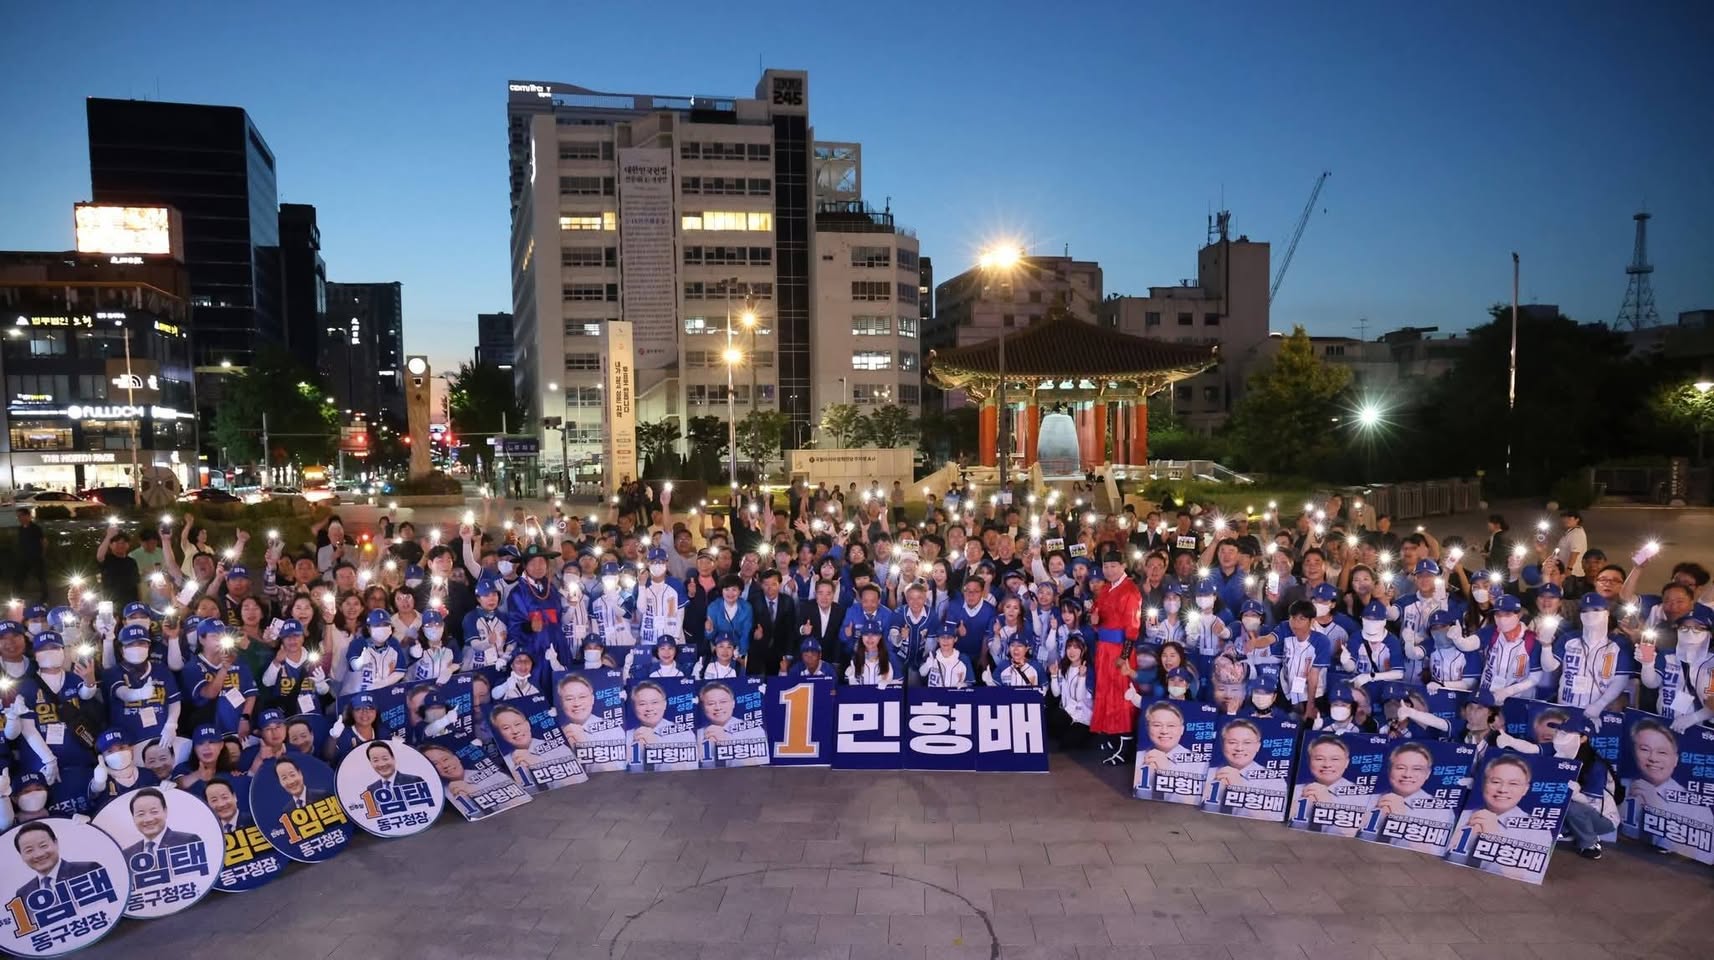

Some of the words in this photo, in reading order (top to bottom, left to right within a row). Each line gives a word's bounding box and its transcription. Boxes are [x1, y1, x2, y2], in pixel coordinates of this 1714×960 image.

[773, 90, 803, 106] 245
[624, 165, 668, 176] 대한민국헌법
[31, 316, 69, 326] 법무법인
[39, 633, 55, 641] 임택
[130, 627, 144, 636] 임택
[1513, 654, 1527, 679] 1
[1600, 652, 1616, 679] 1
[457, 676, 472, 684] 민주당
[607, 670, 621, 678] 민주당
[1561, 655, 1580, 704] 민형배
[391, 687, 405, 695] 민주당
[596, 687, 621, 700] 압도적
[1661, 671, 1680, 719] 민형배
[604, 697, 622, 707] 성장
[668, 693, 694, 706] 압도적
[736, 692, 761, 705] 압도적
[677, 702, 694, 712] 성장
[745, 701, 762, 710] 성장
[1201, 704, 1217, 713] 민주당
[264, 711, 279, 720] 임택
[381, 704, 405, 723] 압도적
[603, 709, 610, 719] 더
[614, 707, 623, 718] 큰
[675, 714, 684, 724] 더
[686, 712, 694, 722] 큰
[743, 712, 753, 721] 더
[754, 709, 763, 719] 큰
[389, 714, 406, 729] 성장
[540, 717, 556, 730] 성장
[589, 717, 624, 733] 전남광주
[729, 718, 764, 733] 전남광주
[773, 682, 820, 758] 1
[837, 701, 1044, 755] 민형배
[1281, 721, 1297, 729] 민주당
[1603, 715, 1623, 725] 민주당
[200, 727, 215, 735] 임택
[661, 722, 694, 736] 전남광주
[1186, 722, 1215, 732] 압도적
[105, 730, 122, 741] 임택
[542, 730, 553, 741] 더
[553, 727, 562, 737] 큰
[1194, 731, 1214, 740] 성장
[1370, 736, 1387, 745] 민주당
[534, 735, 566, 755] 전남광주
[1192, 743, 1202, 753] 더
[1203, 743, 1213, 752] 큰
[1263, 738, 1293, 749] 압도적
[576, 744, 627, 765] 민형배
[630, 742, 642, 764] 1
[645, 747, 697, 765] 민형배
[701, 739, 713, 762] 1
[717, 742, 767, 761] 민형배
[1271, 748, 1292, 757] 성장
[1456, 746, 1474, 755] 민주당
[474, 760, 484, 770] 더
[483, 757, 493, 767] 큰
[1174, 752, 1212, 763] 전남광주
[1267, 760, 1277, 769] 더
[1279, 759, 1290, 769] 큰
[1351, 753, 1383, 765] 압도적
[1360, 763, 1382, 773] 성장
[1433, 764, 1467, 776] 압도적
[1557, 761, 1578, 772] 민주당
[470, 764, 500, 784] 전남광주
[515, 765, 534, 787] 1
[532, 760, 582, 785] 민형배
[1137, 765, 1152, 790] 1
[1247, 769, 1289, 780] 전남광주
[1356, 775, 1367, 785] 더
[1435, 788, 1447, 799] 더
[1449, 788, 1462, 799] 큰
[1531, 781, 1569, 793] 압도적
[1687, 781, 1701, 793] 더
[1702, 782, 1714, 795] 큰
[360, 789, 383, 819] 1
[373, 781, 435, 816] 임택
[456, 795, 478, 817] 1
[474, 783, 523, 810] 민형배
[1206, 780, 1221, 805] 1
[1224, 790, 1284, 812] 민형배
[1540, 793, 1566, 805] 성장
[1665, 790, 1714, 807] 전남광주
[349, 802, 365, 812] 민주당
[1294, 797, 1309, 822] 1
[1412, 798, 1459, 809] 전남광주
[290, 795, 348, 841] 임택
[1532, 807, 1545, 818] 더
[1546, 807, 1561, 819] 큰
[376, 810, 429, 832] 동구청장
[1505, 817, 1557, 830] 전남광주
[1622, 798, 1639, 829] 1
[1643, 812, 1712, 853] 민형배
[279, 812, 302, 845] 1
[1364, 809, 1381, 833] 1
[1382, 819, 1450, 847] 민형배
[299, 828, 346, 858] 동구청장
[1452, 827, 1473, 855] 1
[1473, 839, 1547, 873] 민형배
[130, 841, 210, 890] 임택
[220, 856, 278, 887] 동구청장
[4, 895, 39, 939] 1
[26, 867, 118, 930] 임택
[128, 882, 197, 912] 동구청장
[30, 910, 109, 953] 동구청장
